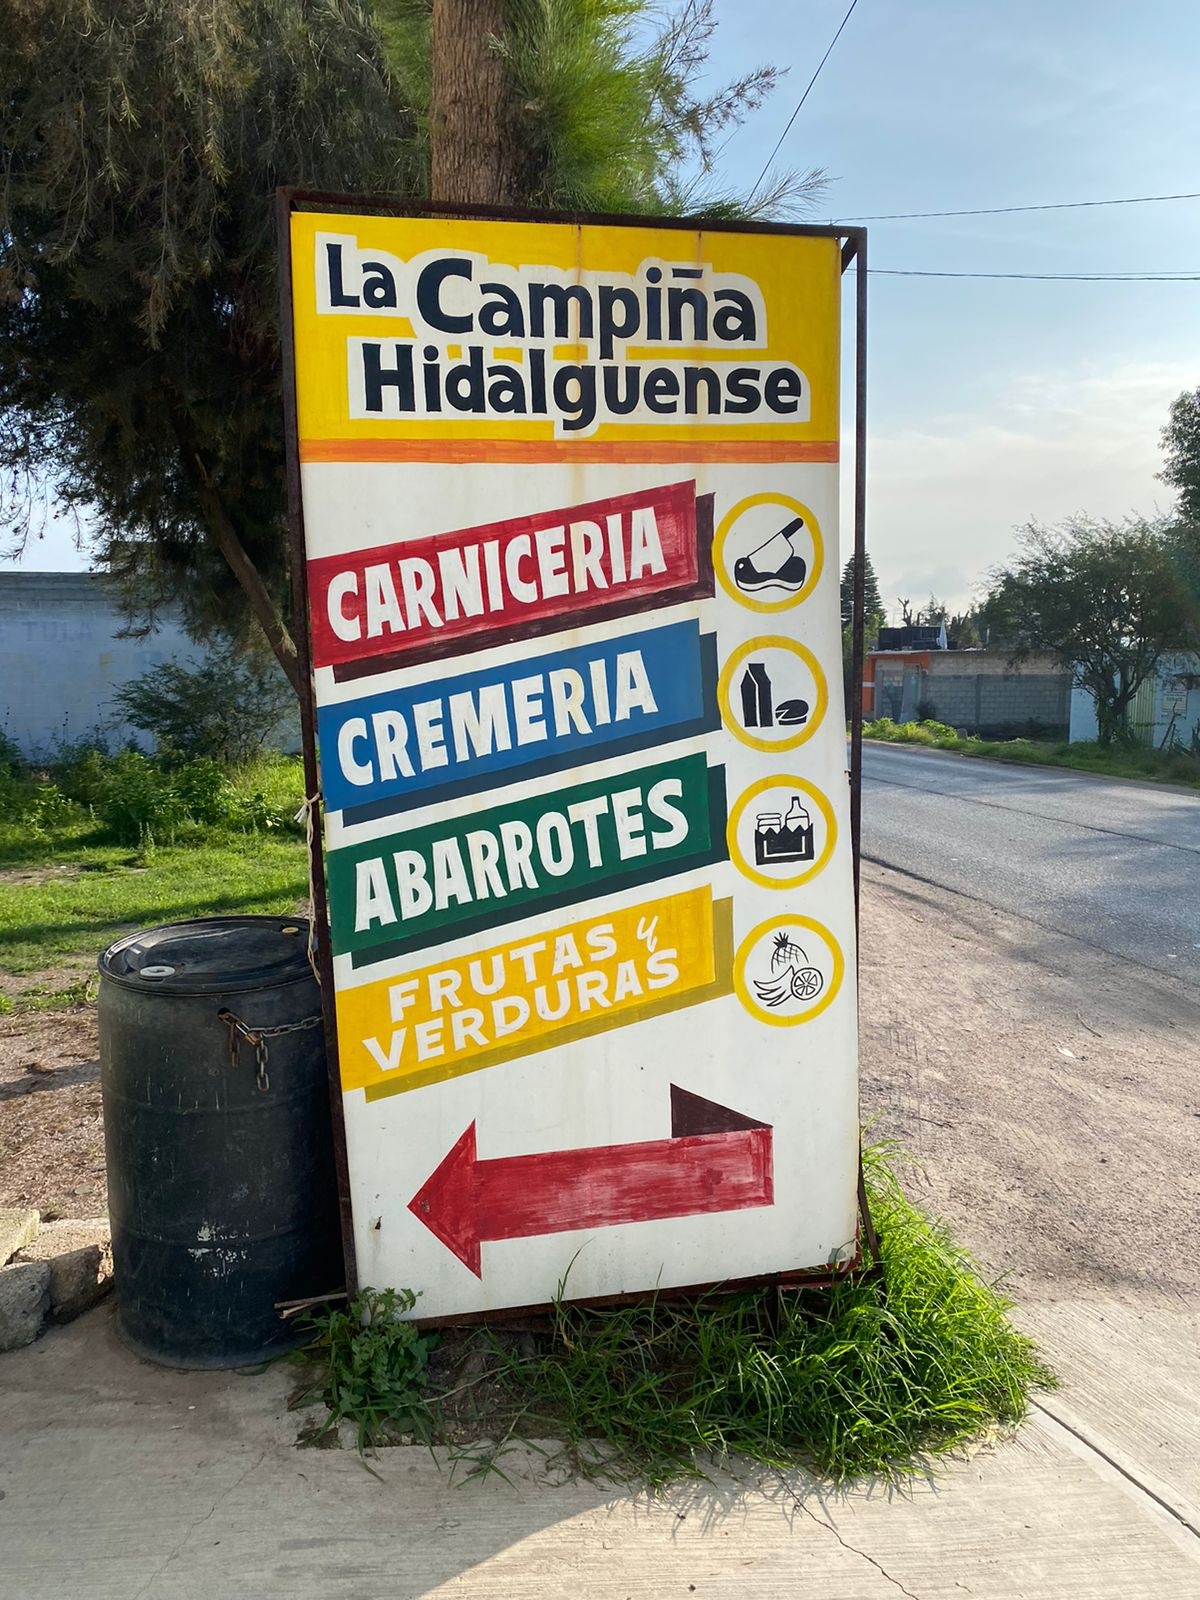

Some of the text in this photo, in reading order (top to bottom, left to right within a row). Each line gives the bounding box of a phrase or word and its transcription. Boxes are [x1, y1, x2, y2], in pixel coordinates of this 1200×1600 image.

[326, 243, 757, 360] La Campiña
[362, 343, 801, 431] Hidalguense
[326, 506, 668, 642] CARNICERIA
[337, 649, 659, 786] CREMERIA
[354, 778, 689, 933] ABARROTES
[361, 948, 680, 1072] VERDURAS
[388, 923, 618, 1024] FRUTAS
